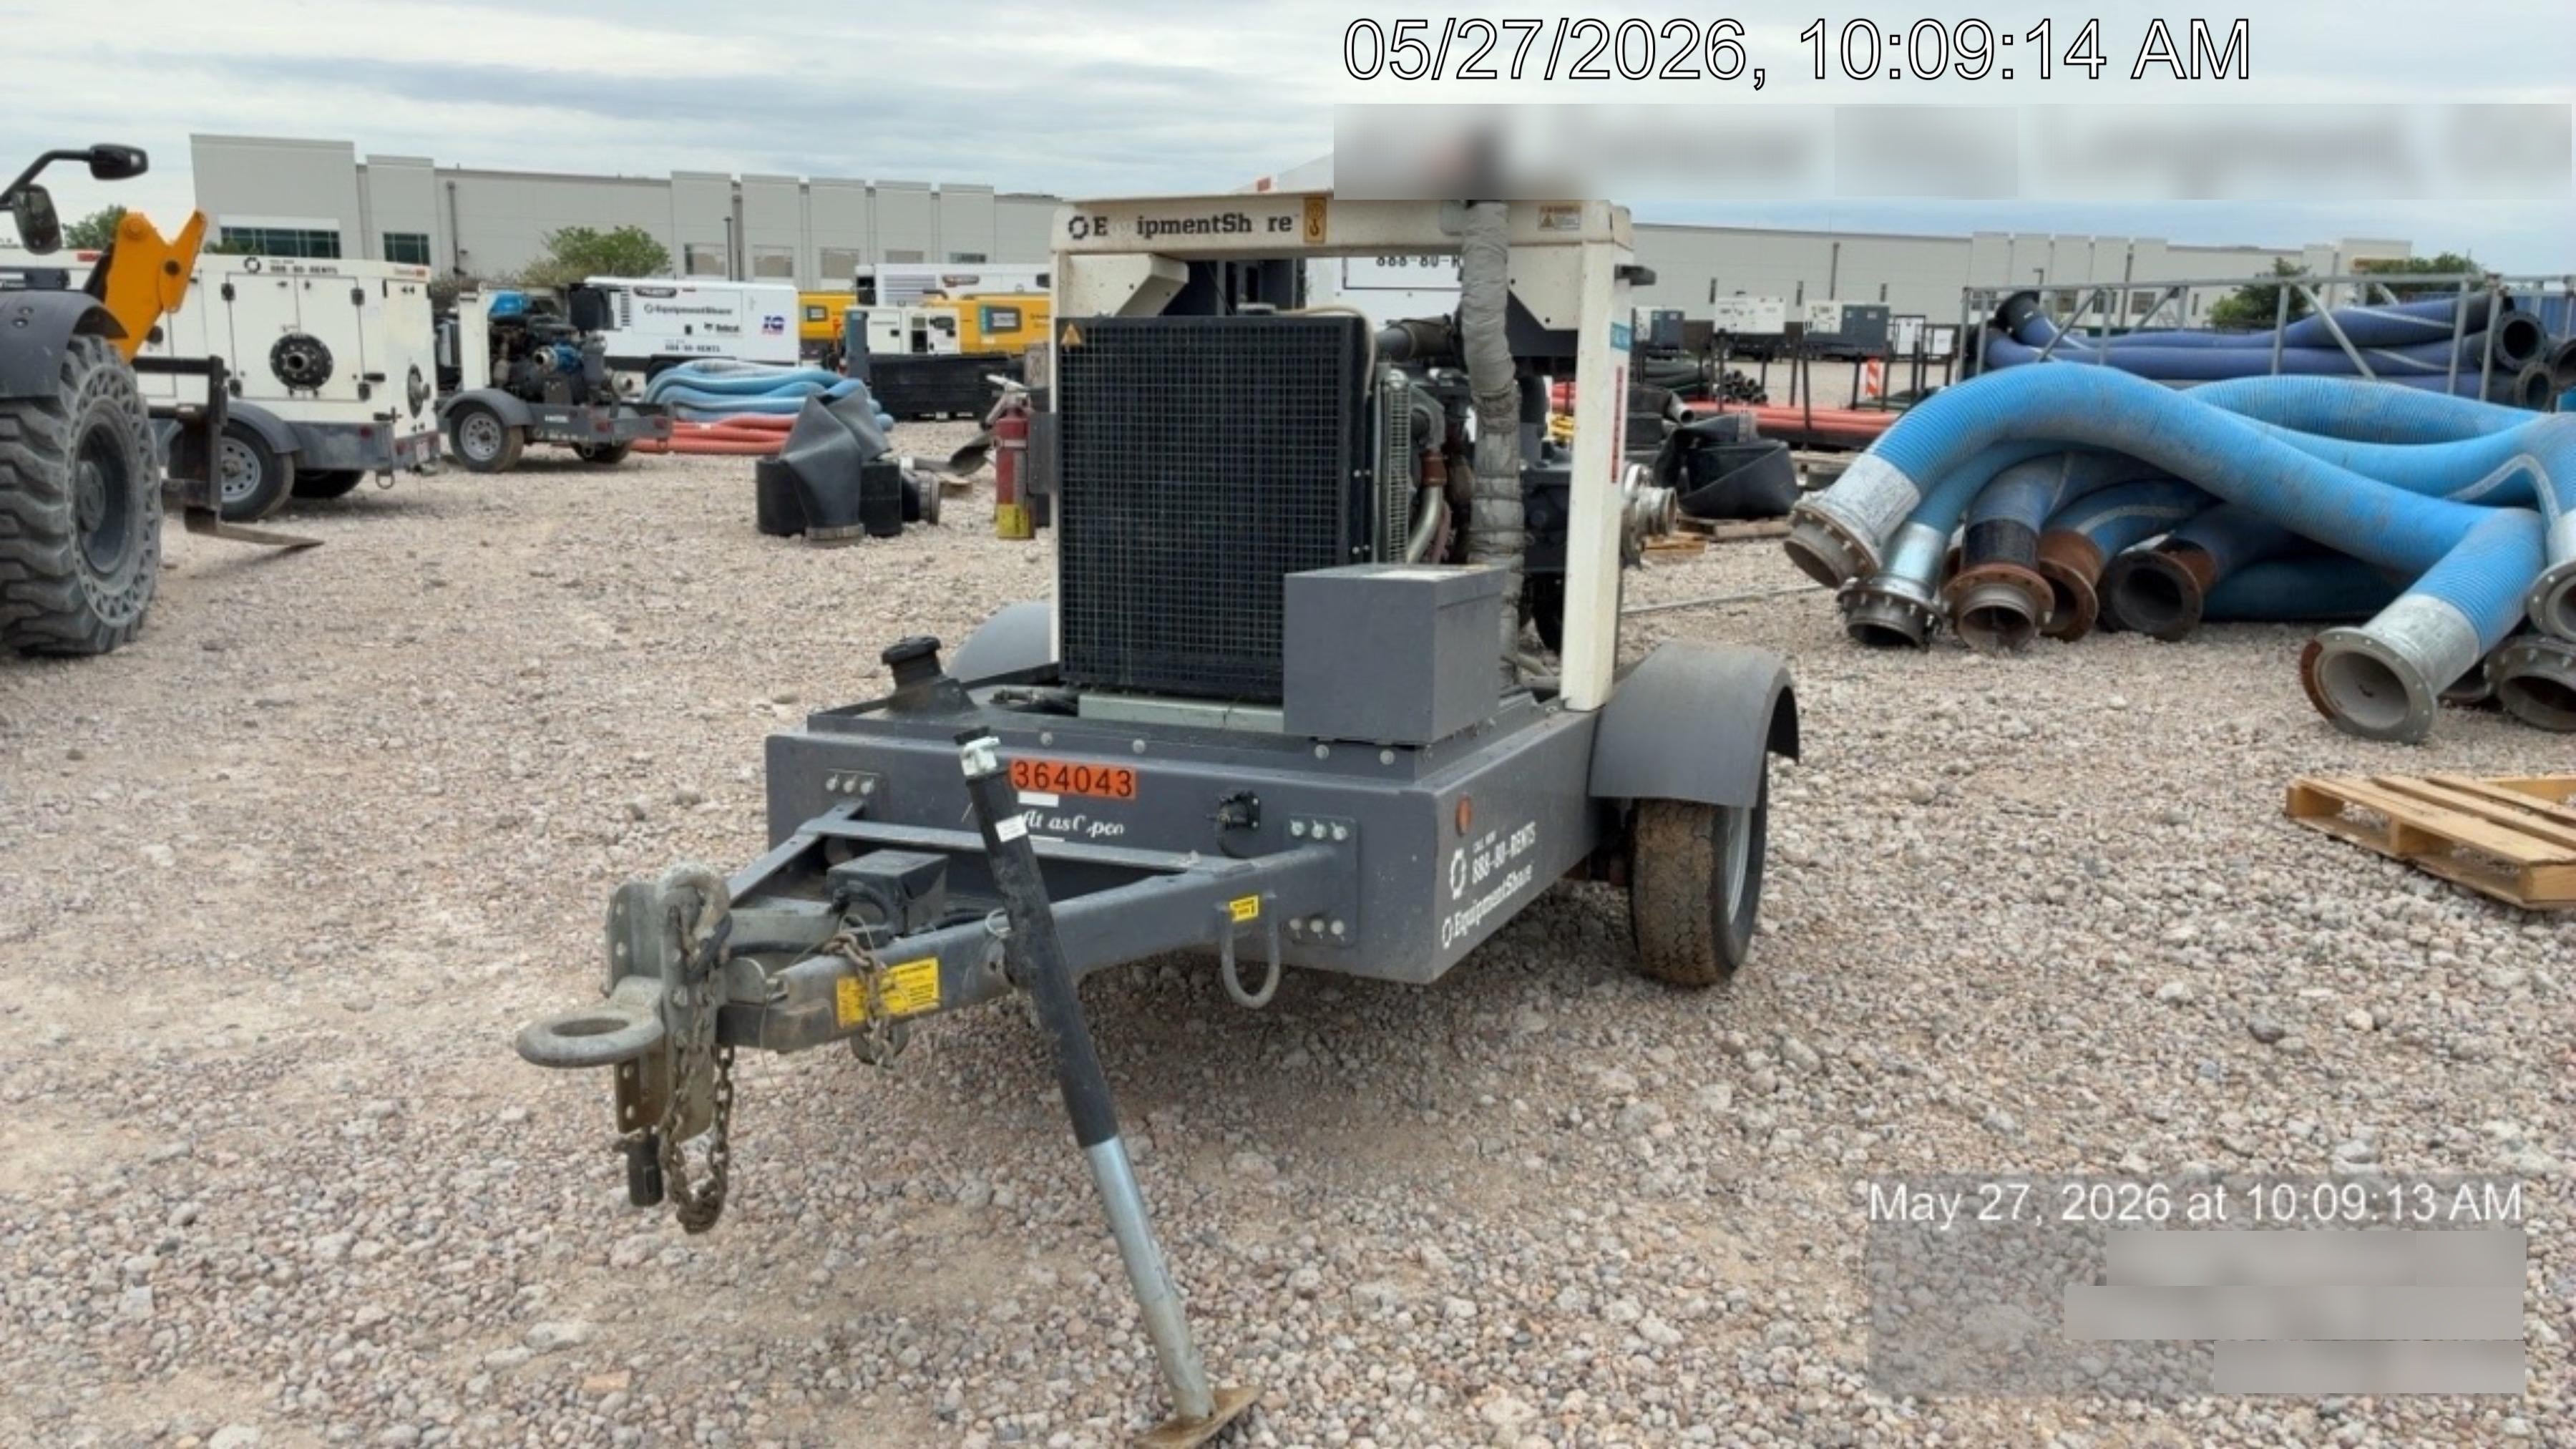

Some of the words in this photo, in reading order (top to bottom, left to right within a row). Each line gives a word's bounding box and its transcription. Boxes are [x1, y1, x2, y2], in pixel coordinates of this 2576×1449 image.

[1093, 213, 1293, 239] EipmentShre
[1376, 255, 1463, 267] 888-80-R
[1014, 761, 1133, 798] 364043
[1454, 864, 1531, 937] EquipmentShare
